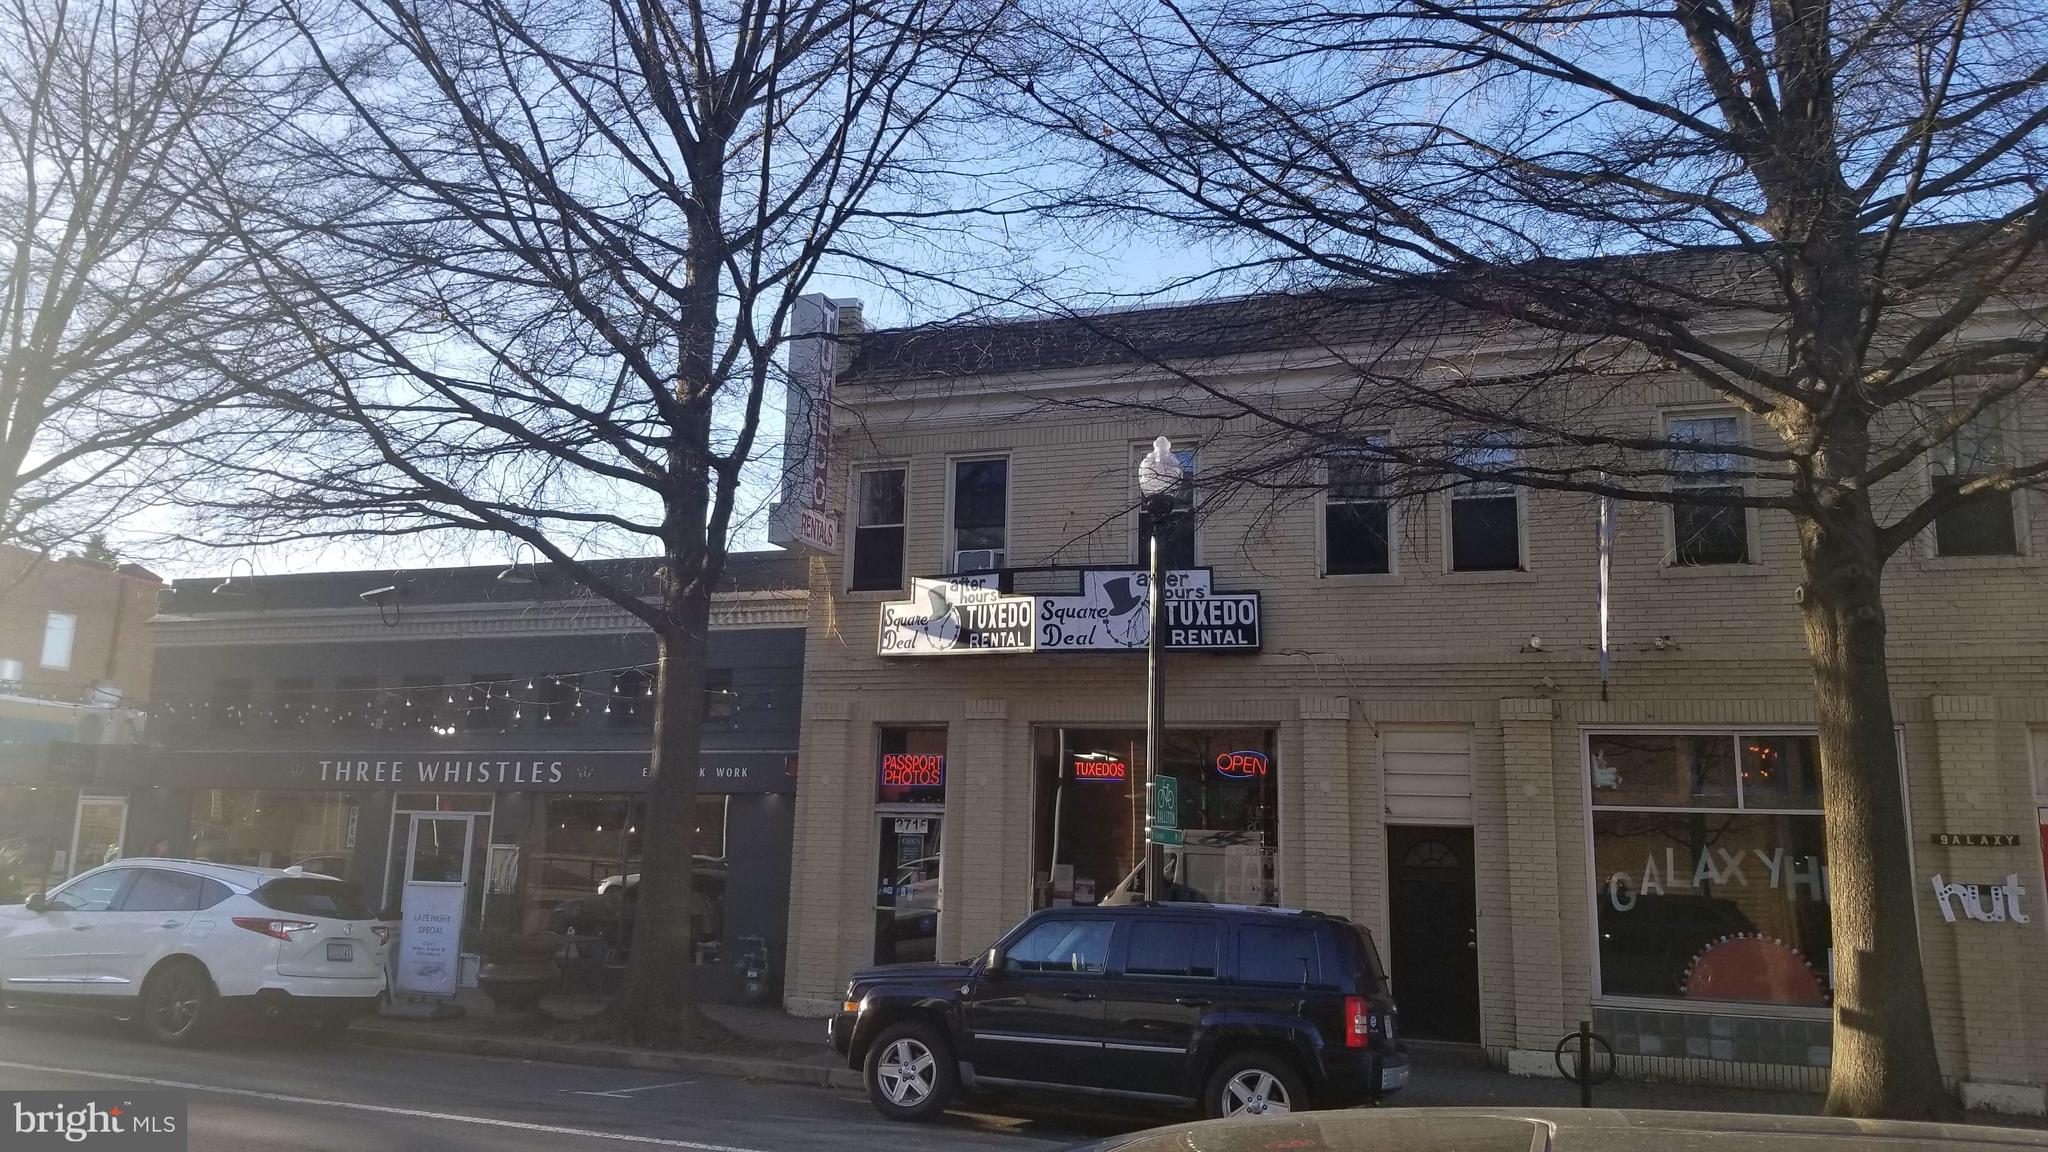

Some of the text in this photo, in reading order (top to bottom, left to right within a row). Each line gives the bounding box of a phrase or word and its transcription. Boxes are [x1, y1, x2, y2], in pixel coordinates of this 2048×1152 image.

[801, 513, 834, 548] RENTALS
[884, 608, 929, 632] Square
[967, 601, 1031, 629] TUXEDO
[1040, 600, 1108, 625] Square
[1165, 600, 1255, 626] TUXEDO
[884, 629, 919, 650] Deal
[970, 631, 1025, 648] RENTAL
[1040, 624, 1097, 647] Deal
[1171, 629, 1249, 645] RENTAL
[318, 761, 563, 783] THREE WHISTLES
[716, 768, 748, 778] WORK
[884, 755, 943, 770] PASSPORT
[1074, 762, 1125, 777] TUXEDOS
[1216, 753, 1269, 776] OPEN
[884, 769, 940, 785] PHOTOS
[1610, 844, 1784, 912] GALAXY
[1931, 872, 2030, 923] hut
